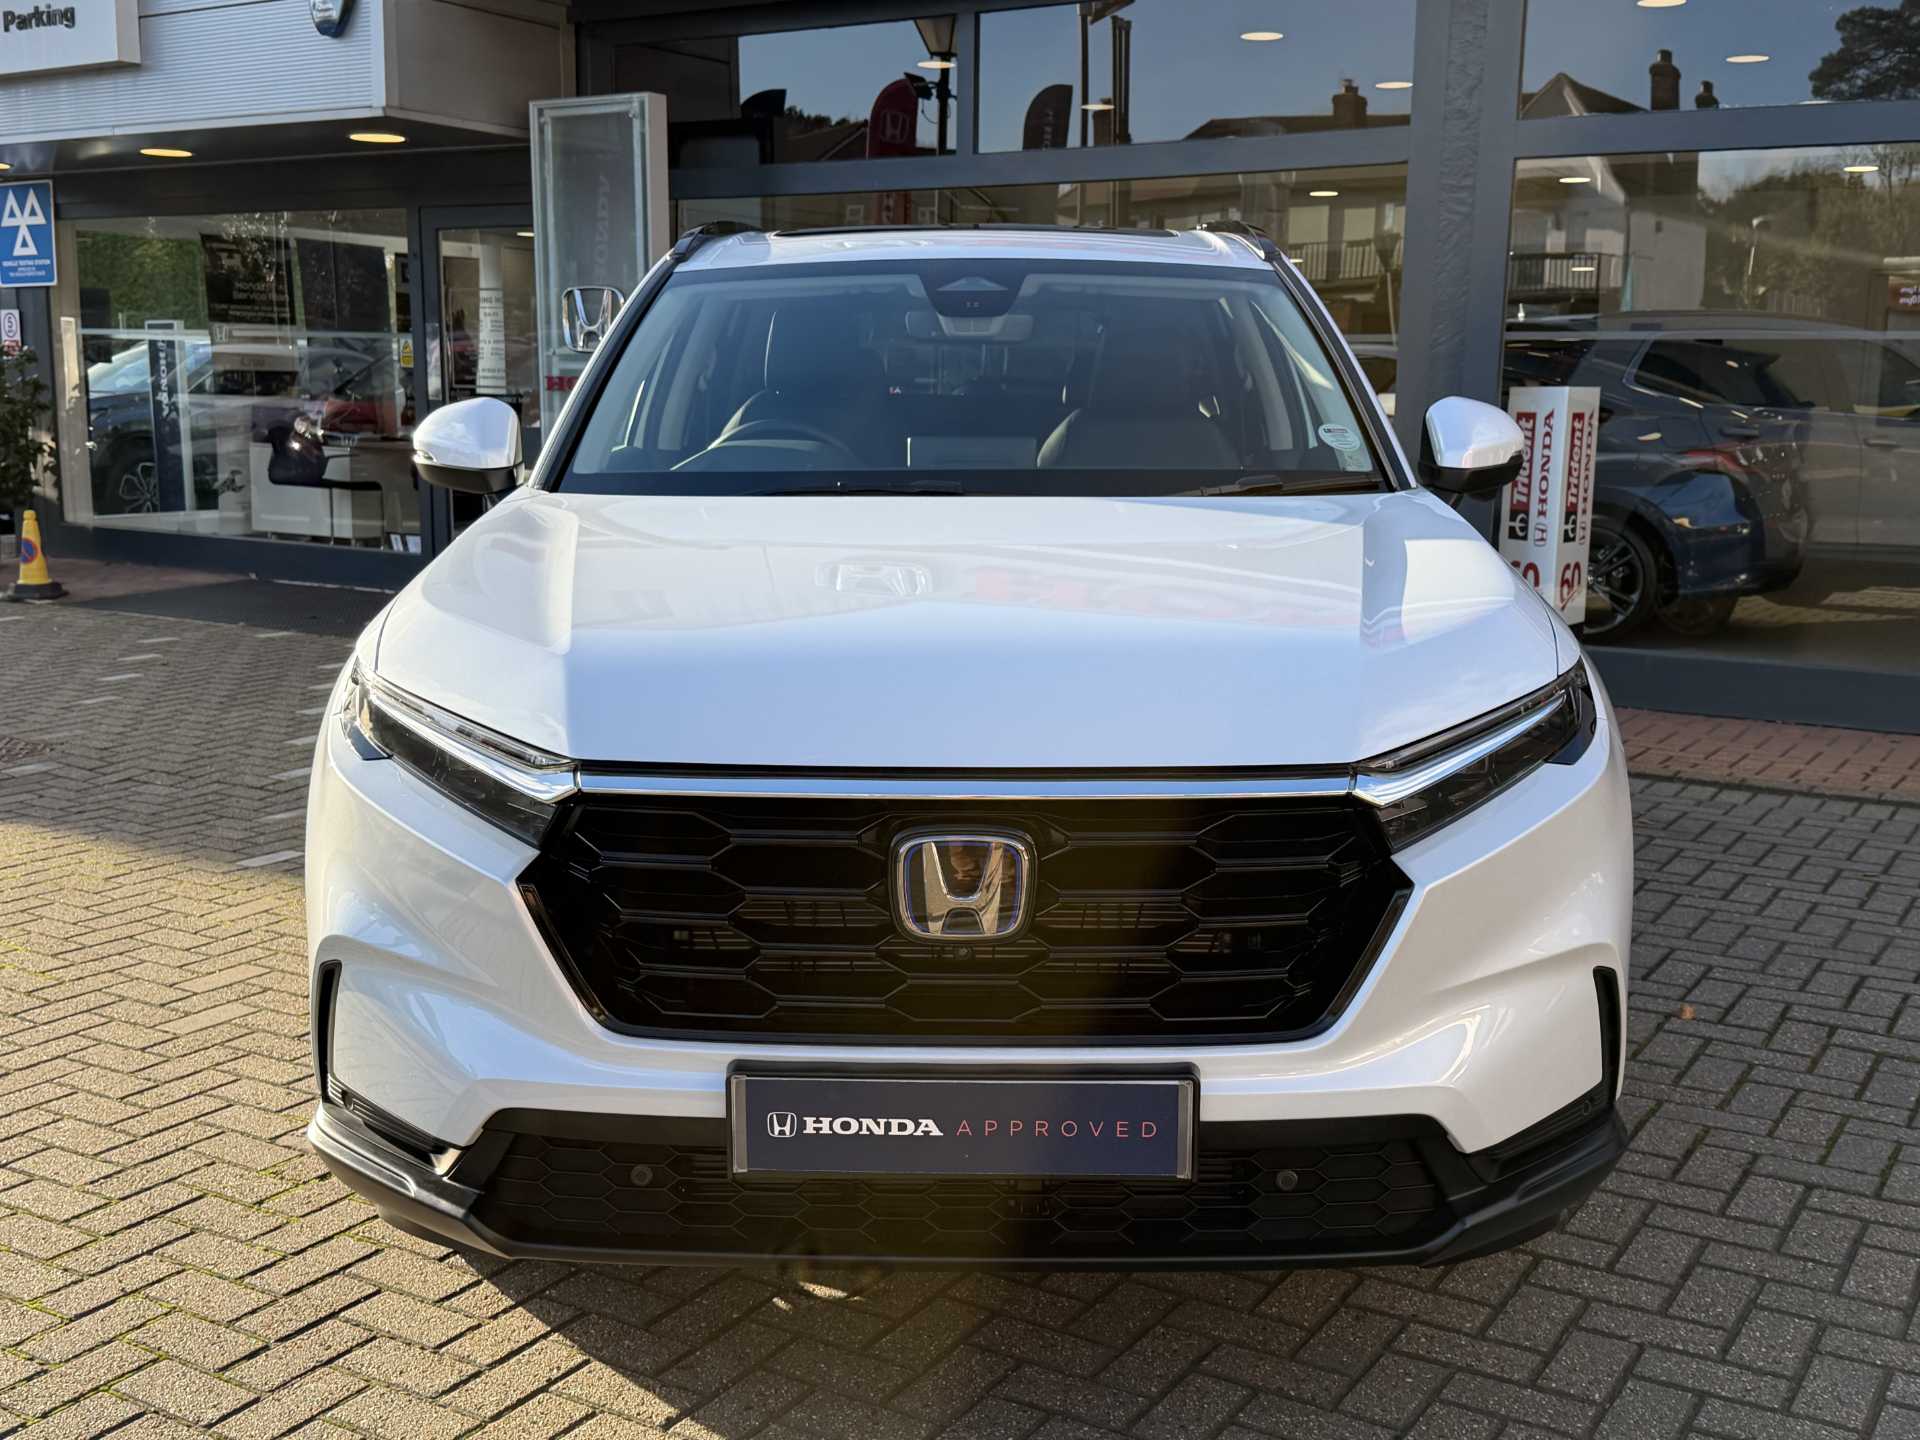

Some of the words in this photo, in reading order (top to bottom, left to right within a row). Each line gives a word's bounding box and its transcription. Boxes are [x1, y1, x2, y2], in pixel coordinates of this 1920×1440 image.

[3, 4, 76, 32] Parking
[1536, 408, 1556, 519] HONDA
[1567, 417, 1585, 508] Trident
[1580, 408, 1595, 518] HONDA
[802, 1116, 944, 1137] HONDA
[956, 1119, 1158, 1138] APPROVED
